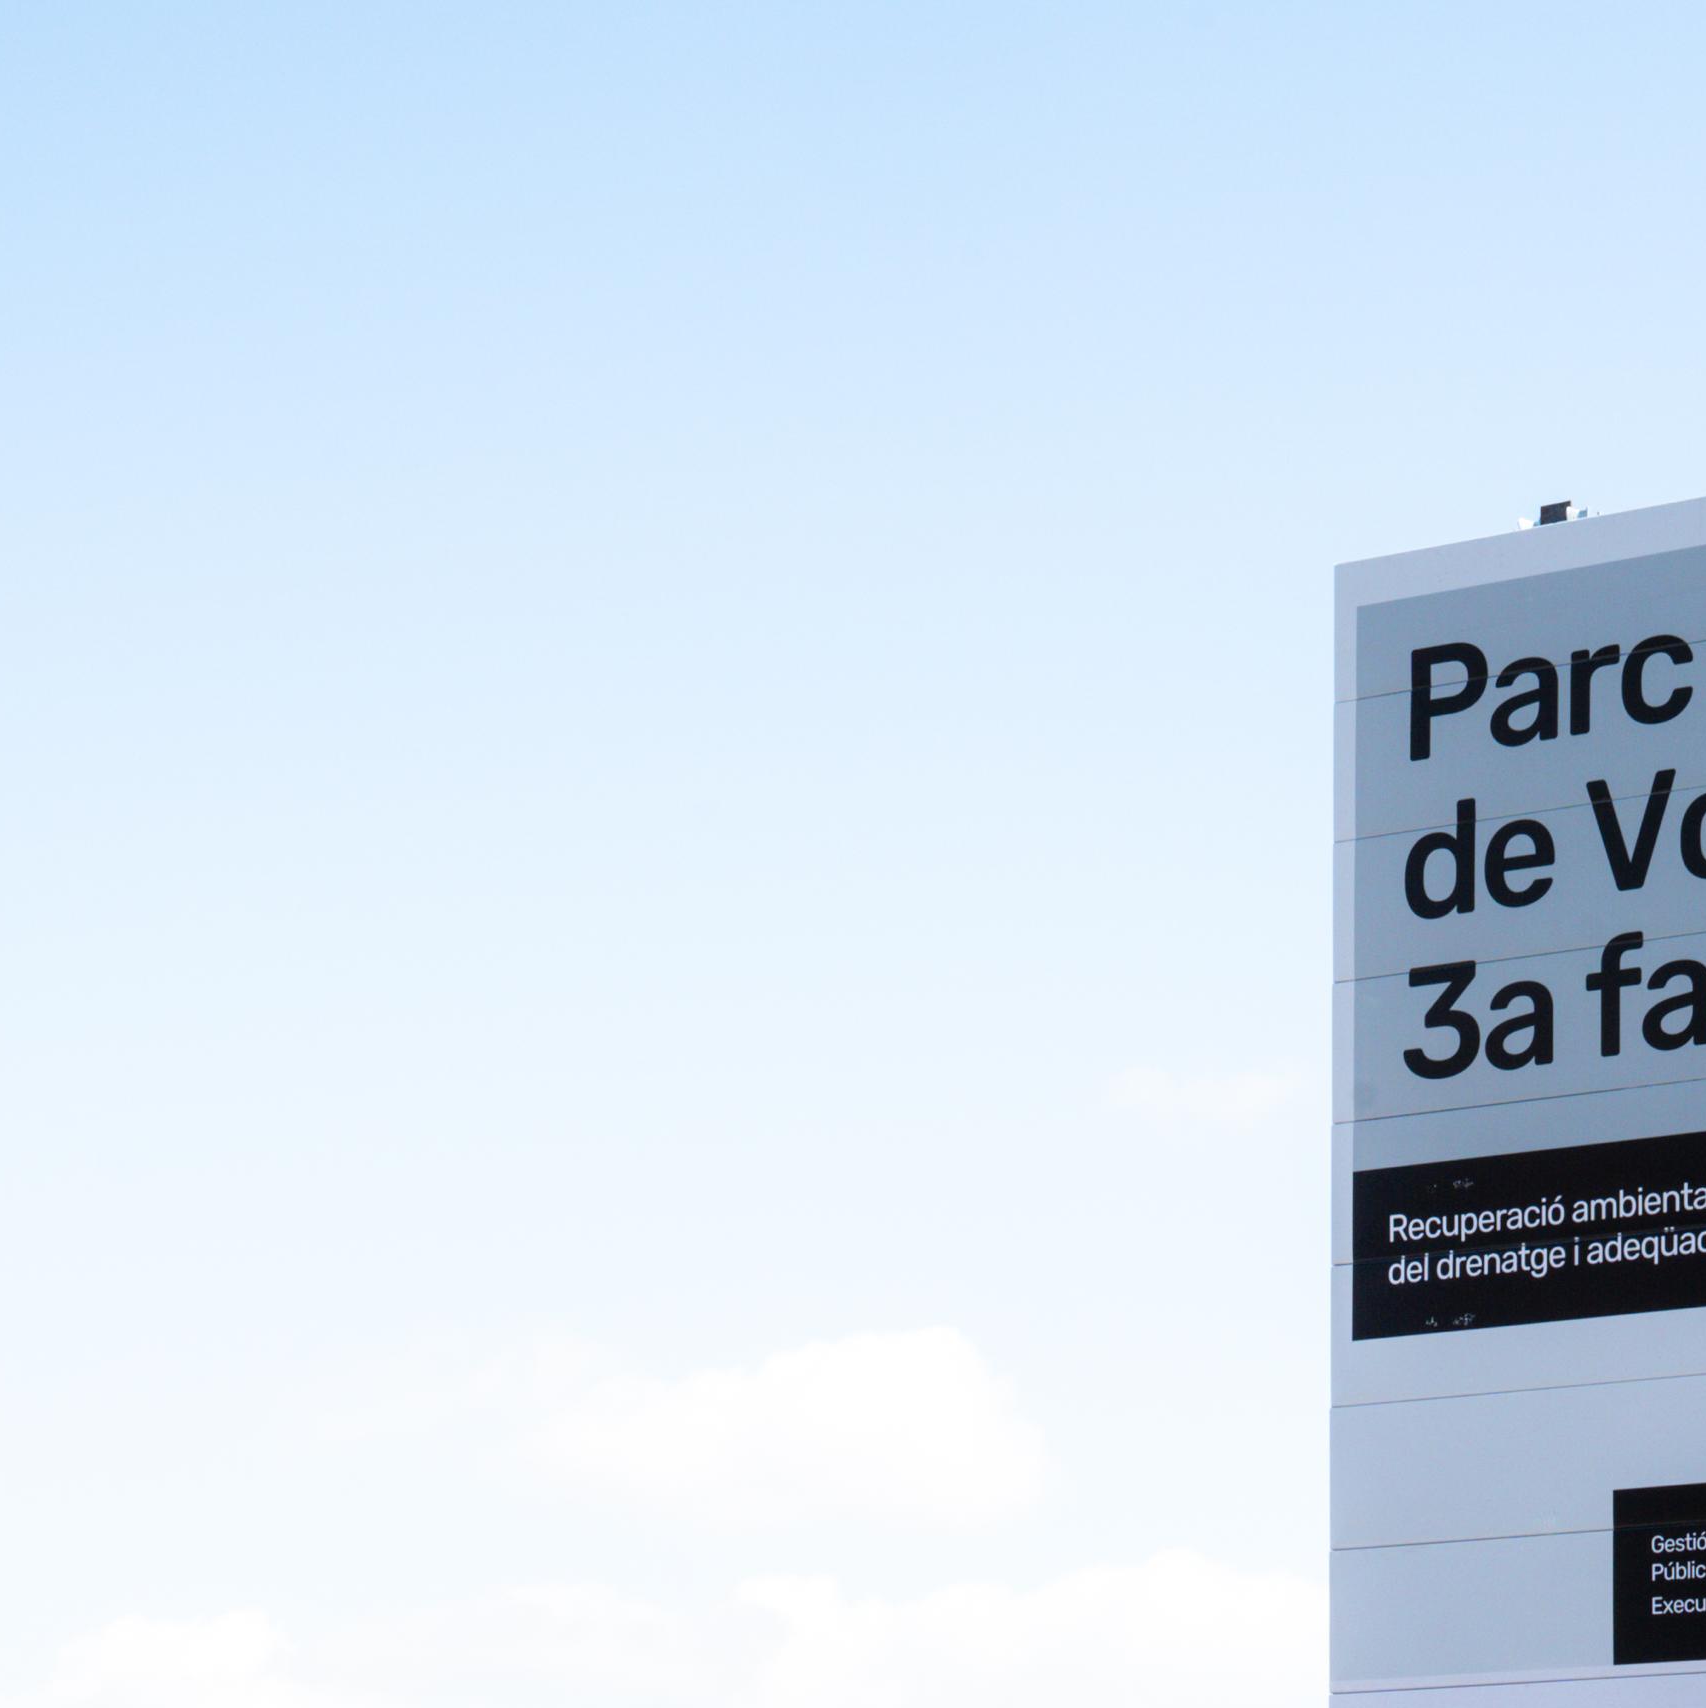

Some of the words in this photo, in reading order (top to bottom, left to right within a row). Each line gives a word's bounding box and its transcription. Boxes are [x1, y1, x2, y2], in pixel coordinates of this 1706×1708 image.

[1410, 634, 1693, 760] Parc
[1403, 798, 1555, 920] de
[1402, 960, 1554, 1080] 3a
[1389, 1196, 1565, 1243] Recuperació
[1388, 1256, 1429, 1285] del
[1437, 1242, 1566, 1281] drenatge
[1573, 1241, 1580, 1266] i
[1651, 1559, 1706, 1582] Públic
